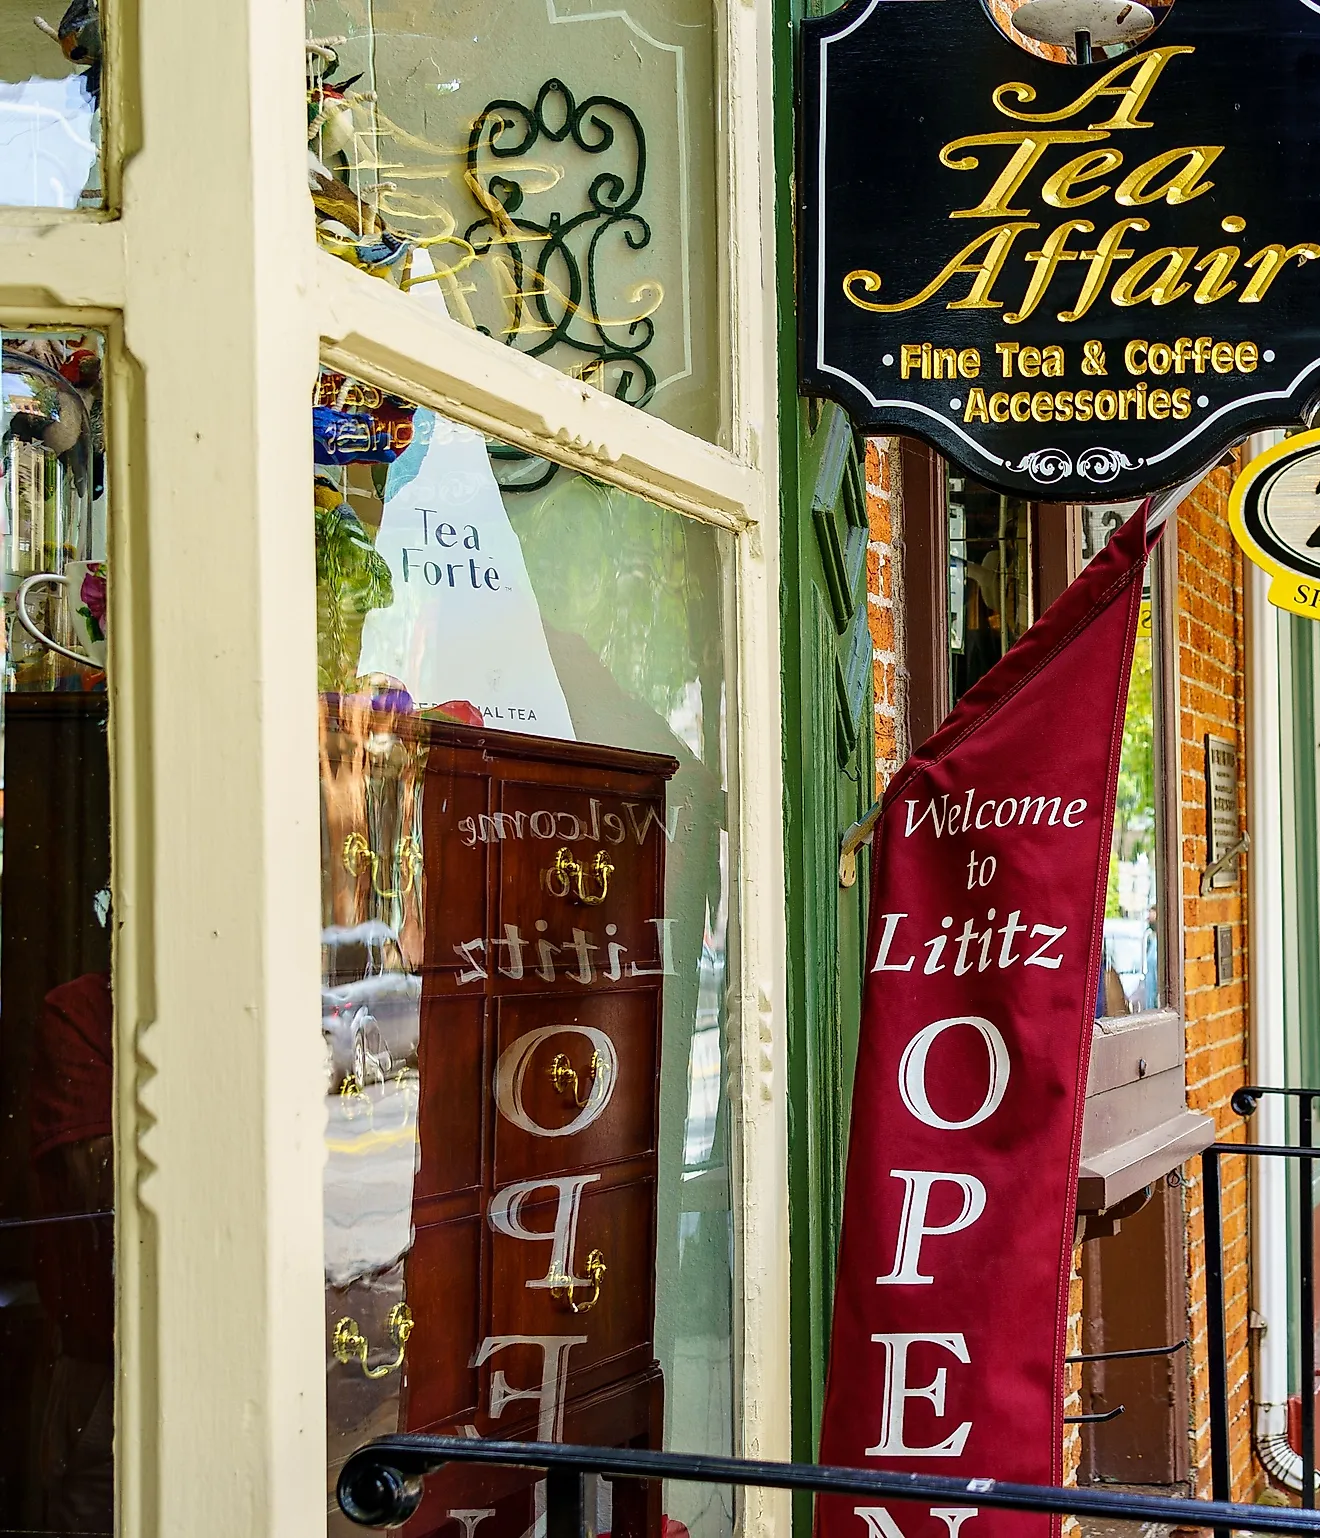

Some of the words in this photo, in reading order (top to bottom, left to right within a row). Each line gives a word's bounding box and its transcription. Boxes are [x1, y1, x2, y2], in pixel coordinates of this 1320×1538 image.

[991, 45, 1196, 131] A
[938, 129, 1226, 219] Tea
[900, 342, 981, 381] Fine
[994, 341, 1065, 378] Tea
[1080, 339, 1109, 376] &
[1124, 336, 1259, 375] Coffee
[963, 381, 1192, 424] Accessories
[414, 507, 481, 551] Tea
[507, 707, 538, 721] TEA
[904, 788, 1088, 839] Welcome
[966, 849, 997, 890] to
[870, 907, 1068, 977] Lititz
[854, 1015, 1011, 1538] OPE
